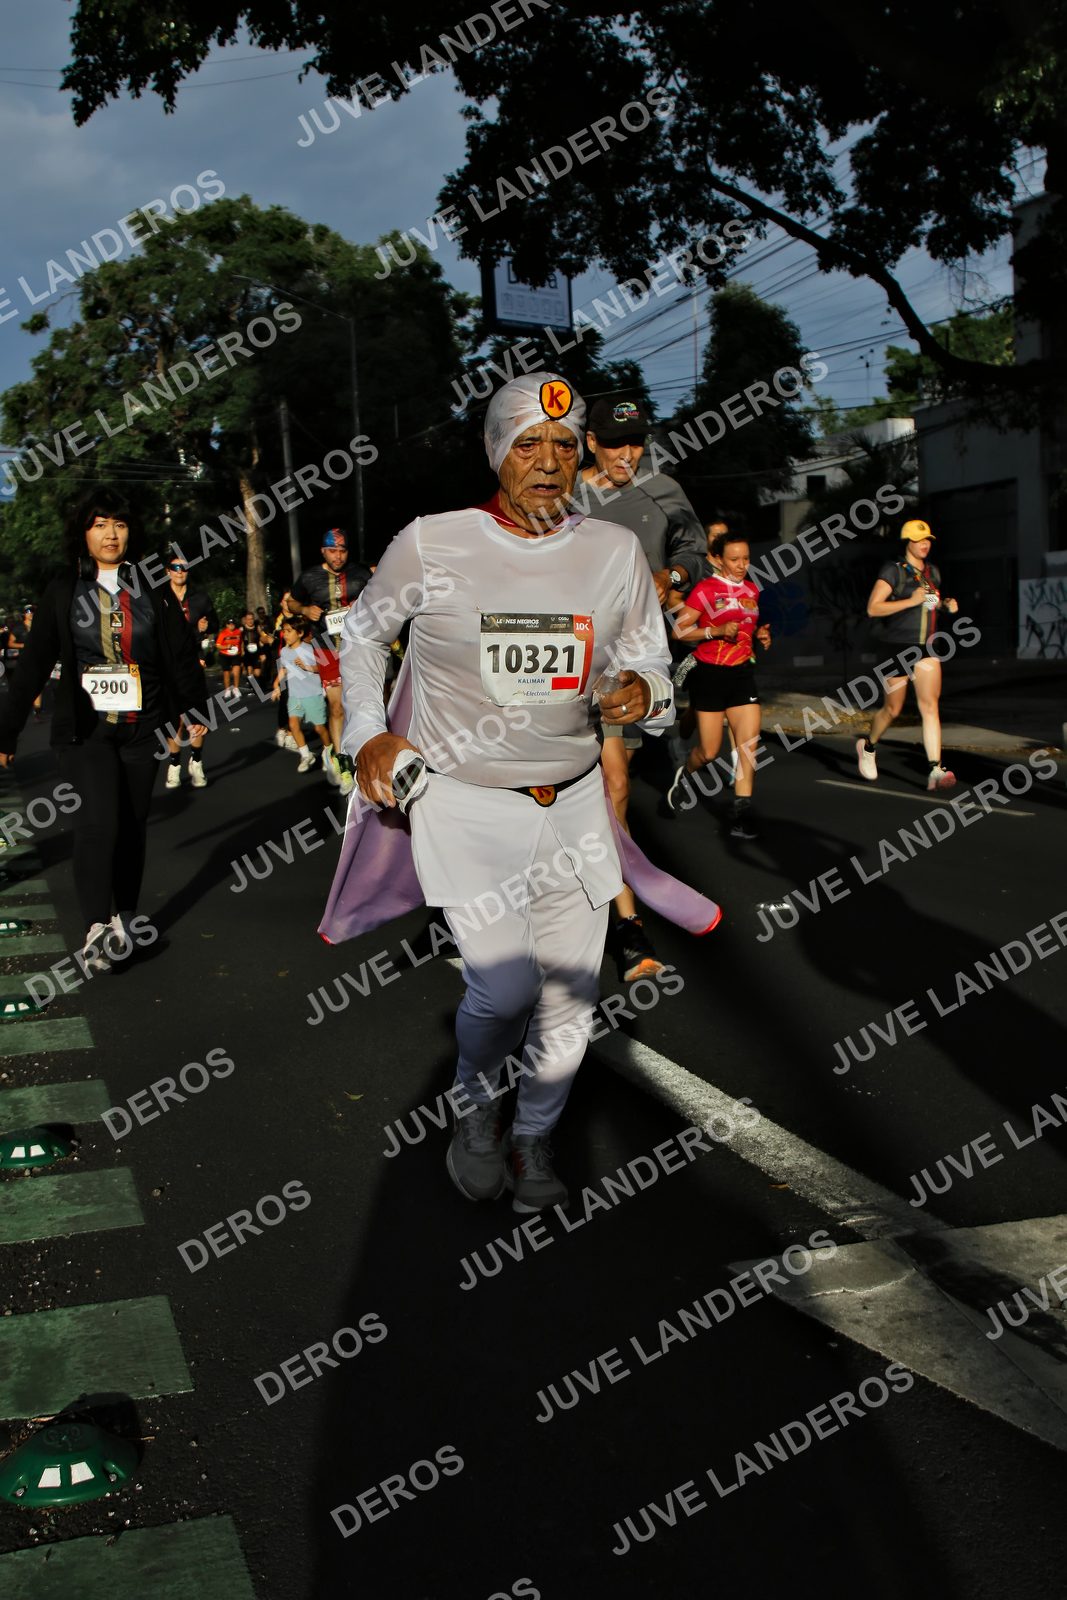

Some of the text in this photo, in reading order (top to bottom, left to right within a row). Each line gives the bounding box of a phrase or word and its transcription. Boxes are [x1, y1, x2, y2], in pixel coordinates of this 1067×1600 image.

[547, 385, 565, 411] K
[328, 615, 345, 625] 100
[486, 644, 575, 673] 10321
[90, 680, 128, 695] 2900
